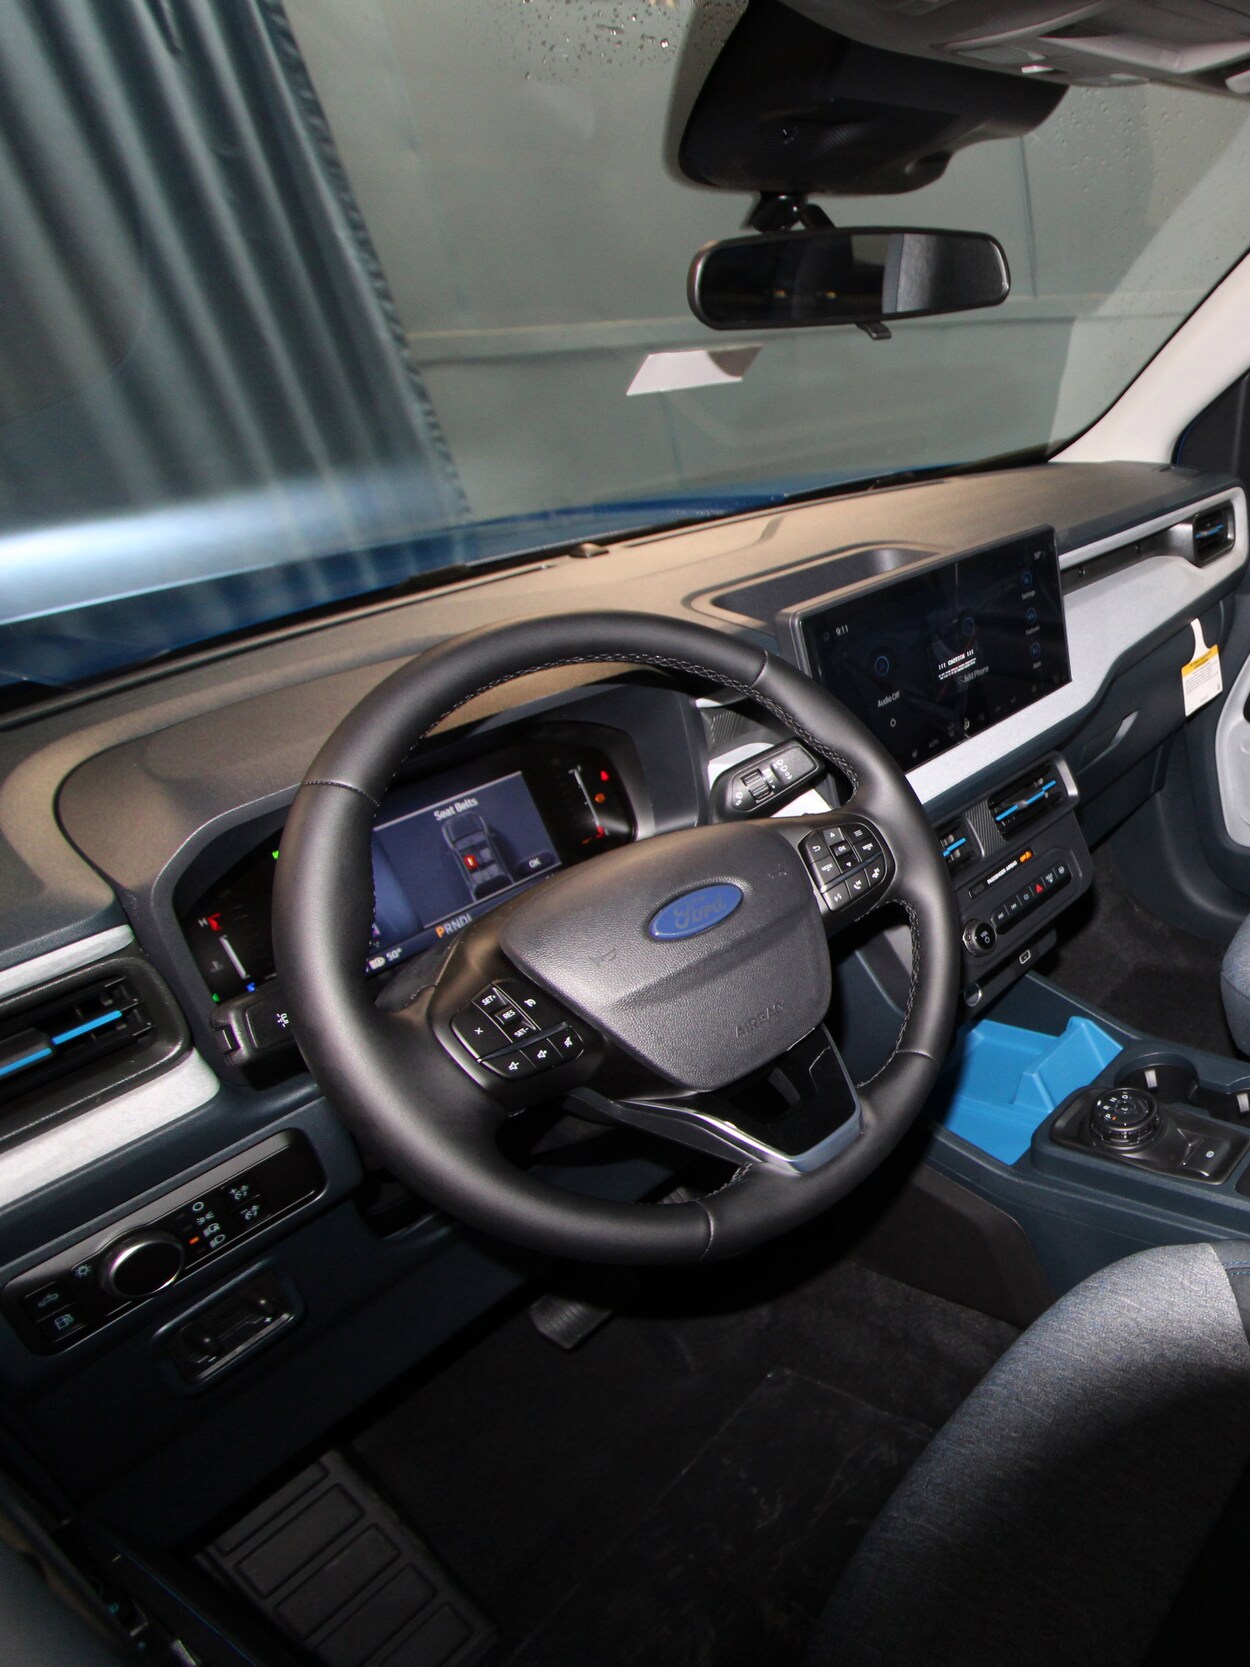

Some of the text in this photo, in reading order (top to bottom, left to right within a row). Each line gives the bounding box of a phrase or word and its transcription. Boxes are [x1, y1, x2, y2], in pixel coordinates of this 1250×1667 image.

[835, 624, 849, 637] 9:11
[877, 695, 893, 708] Audio
[433, 797, 479, 821] Seat Belts
[528, 857, 541, 869] OK
[673, 893, 727, 930] Ford
[502, 1009, 516, 1020] RES
[735, 1001, 784, 1039] AIRBAG
